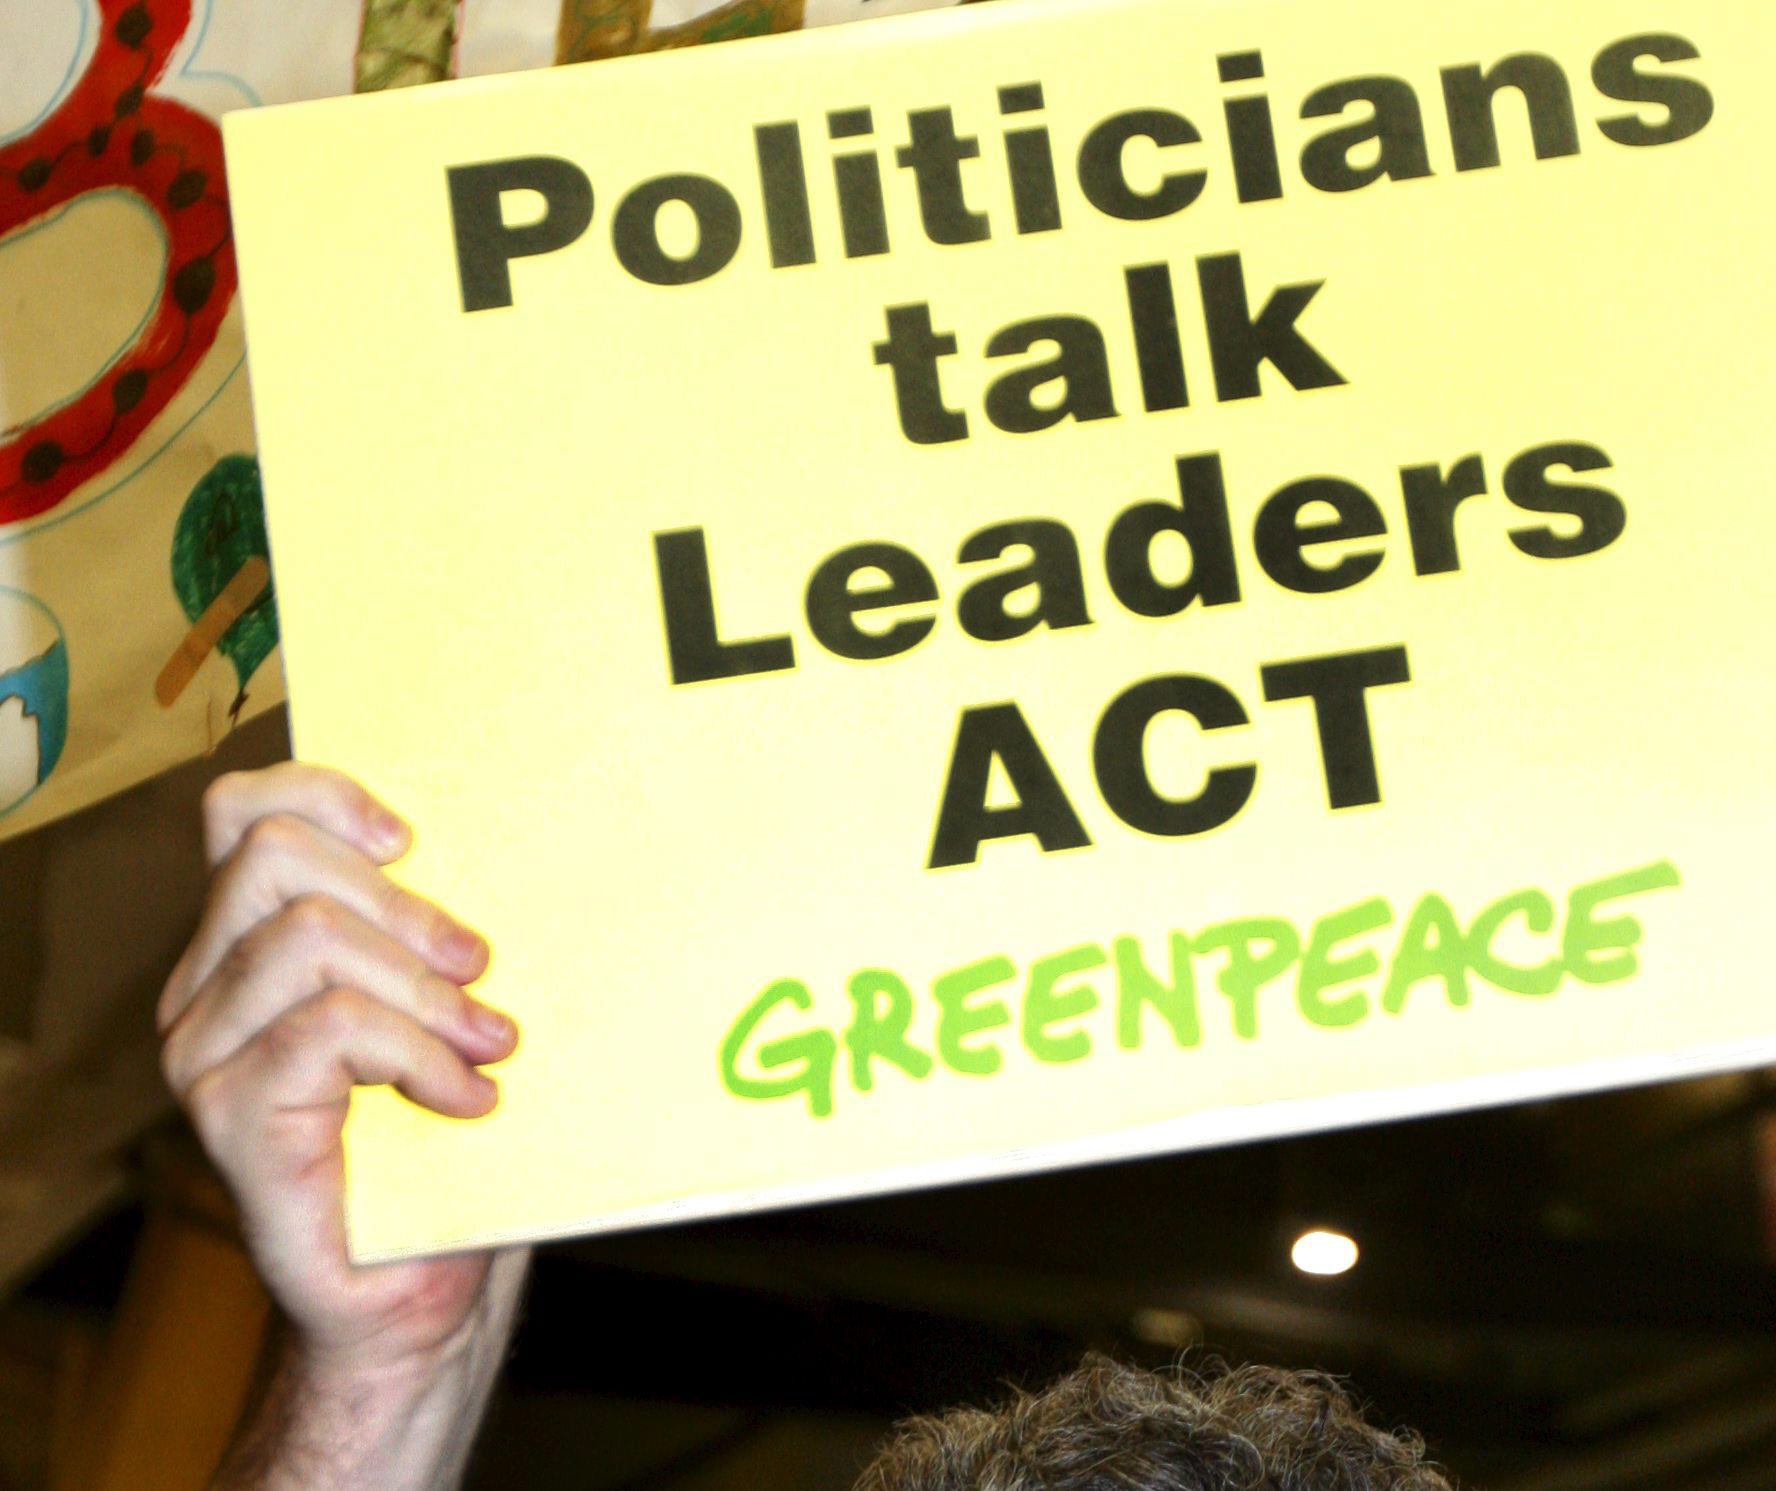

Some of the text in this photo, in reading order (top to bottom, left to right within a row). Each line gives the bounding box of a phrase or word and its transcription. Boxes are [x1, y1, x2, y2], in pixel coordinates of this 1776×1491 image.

[445, 31, 1714, 313] Politicians
[873, 250, 1349, 446] talk
[654, 440, 1628, 686] Leaders
[929, 644, 1411, 870] ACT
[719, 860, 1681, 1119] GREENPEACE
